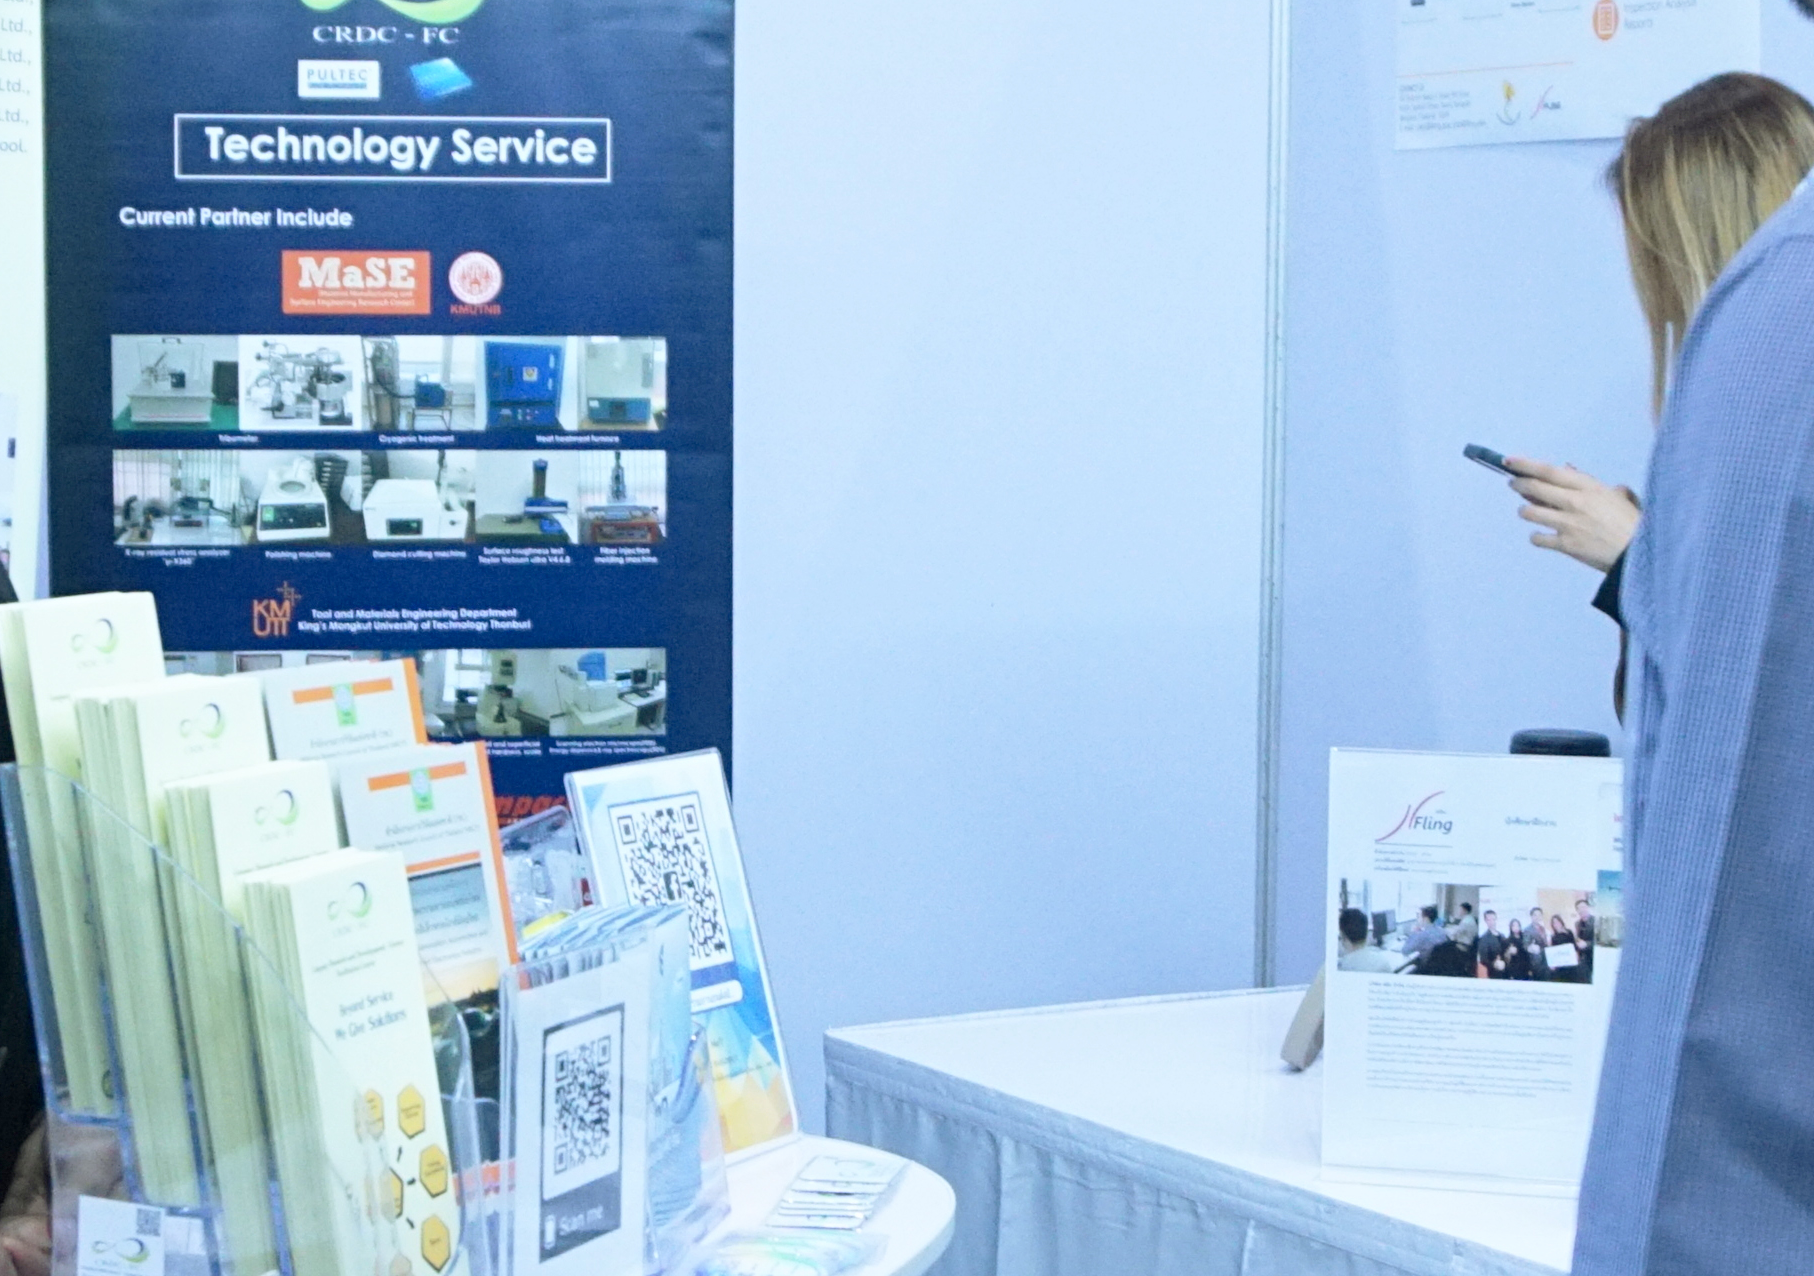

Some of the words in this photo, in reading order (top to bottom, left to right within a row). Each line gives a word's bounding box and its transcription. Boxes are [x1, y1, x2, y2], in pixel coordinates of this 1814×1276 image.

[1, 17, 33, 36] Ltd.,
[312, 26, 397, 45] CRDC
[423, 27, 460, 45] FC
[0, 48, 32, 66] Ltd.,
[307, 68, 368, 81] PULTEC
[204, 126, 440, 171] Technology
[451, 129, 597, 165] Service
[119, 206, 196, 227] Current
[200, 206, 271, 227] Partner
[277, 208, 354, 228] Include
[298, 256, 415, 288] MaSE
[451, 304, 502, 315] KMUTNB
[253, 599, 291, 617] KM
[311, 609, 332, 619] Tool
[334, 609, 353, 619] and
[356, 608, 399, 619] Materials
[401, 608, 458, 621] Engineering
[460, 608, 517, 621] Department
[298, 620, 327, 633] King's
[329, 620, 372, 633] Mongkut
[373, 620, 419, 632] University
[420, 620, 431, 631] of
[432, 620, 488, 632] Technology
[490, 619, 532, 630] Thonburi
[1412, 815, 1453, 835] Fling
[559, 1213, 584, 1236] Scan
[587, 1204, 604, 1222] me
